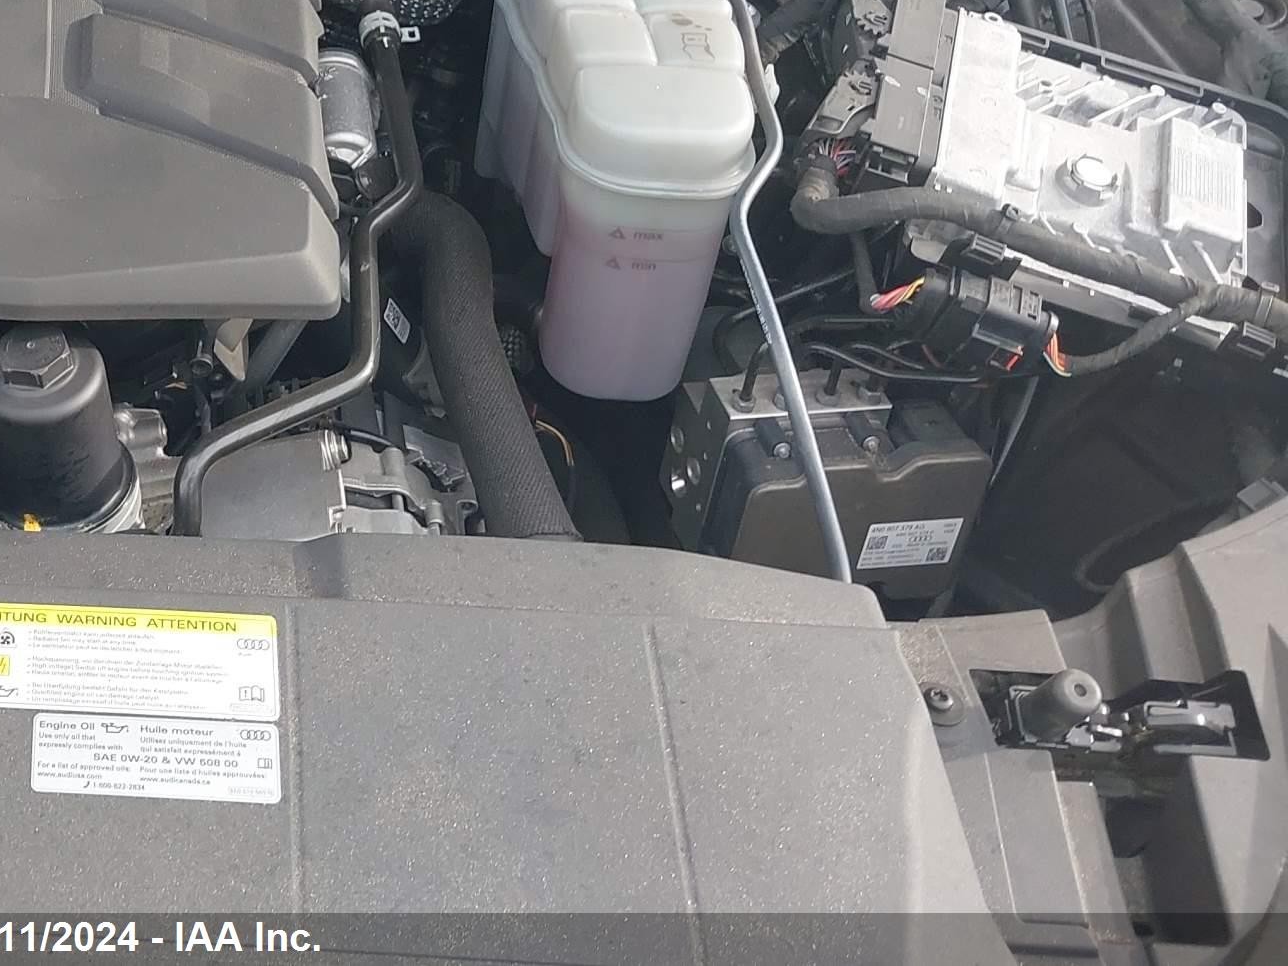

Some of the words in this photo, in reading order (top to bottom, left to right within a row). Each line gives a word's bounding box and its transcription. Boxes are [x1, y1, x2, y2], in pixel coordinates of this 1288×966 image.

[633, 231, 663, 242] max
[631, 261, 657, 272] min
[56, 613, 137, 627] WARNING
[146, 617, 237, 632] ATTENTION
[39, 721, 76, 730] Engine
[80, 722, 95, 730] Oil
[140, 725, 168, 734] Huile
[171, 727, 214, 736] moteur
[73, 743, 106, 751] complies
[214, 739, 223, 747] de
[93, 753, 117, 761] SAE
[120, 754, 158, 764] 0W-20
[162, 756, 170, 764] &
[175, 757, 196, 765] VW
[224, 759, 239, 768] 00
[80, 763, 115, 771] approved
[174, 767, 190, 775] liste
